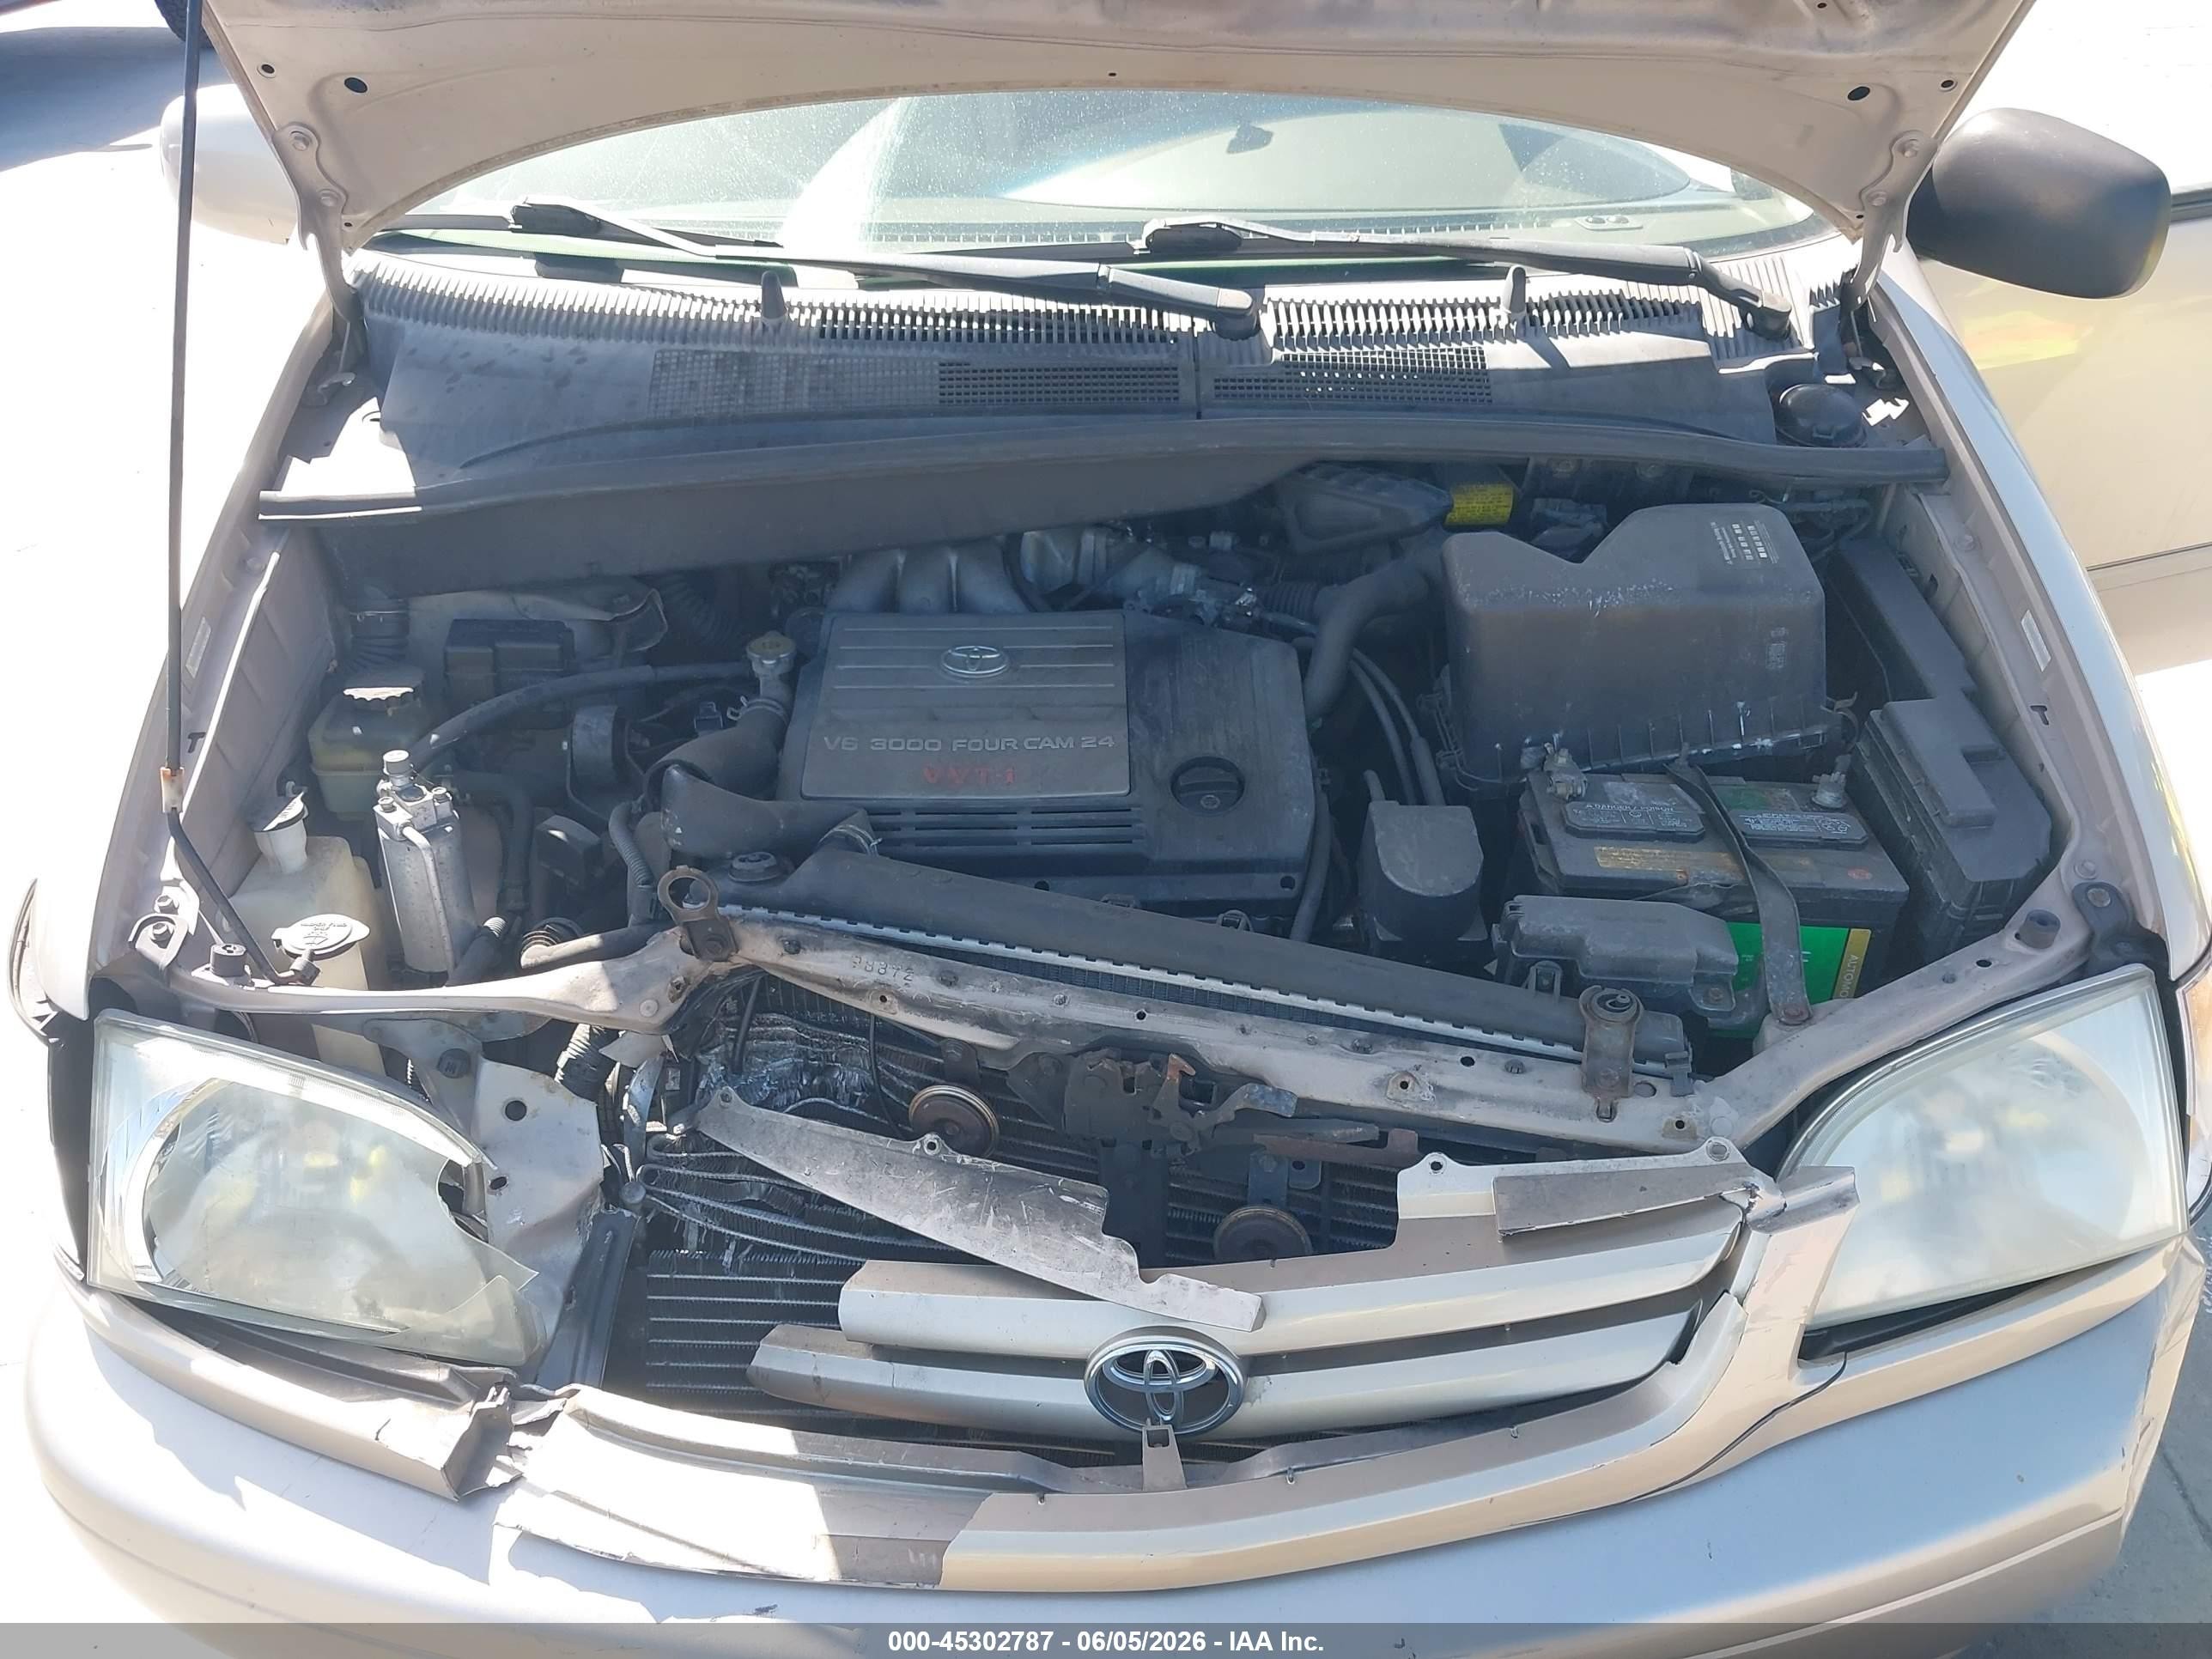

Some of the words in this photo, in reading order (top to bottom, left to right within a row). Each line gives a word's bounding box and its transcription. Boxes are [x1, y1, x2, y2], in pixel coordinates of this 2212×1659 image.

[823, 737, 859, 750] V6
[870, 738, 942, 751] 3000
[951, 737, 1019, 751] FOUR
[1023, 736, 1075, 750] CAM
[1080, 735, 1116, 749] 24
